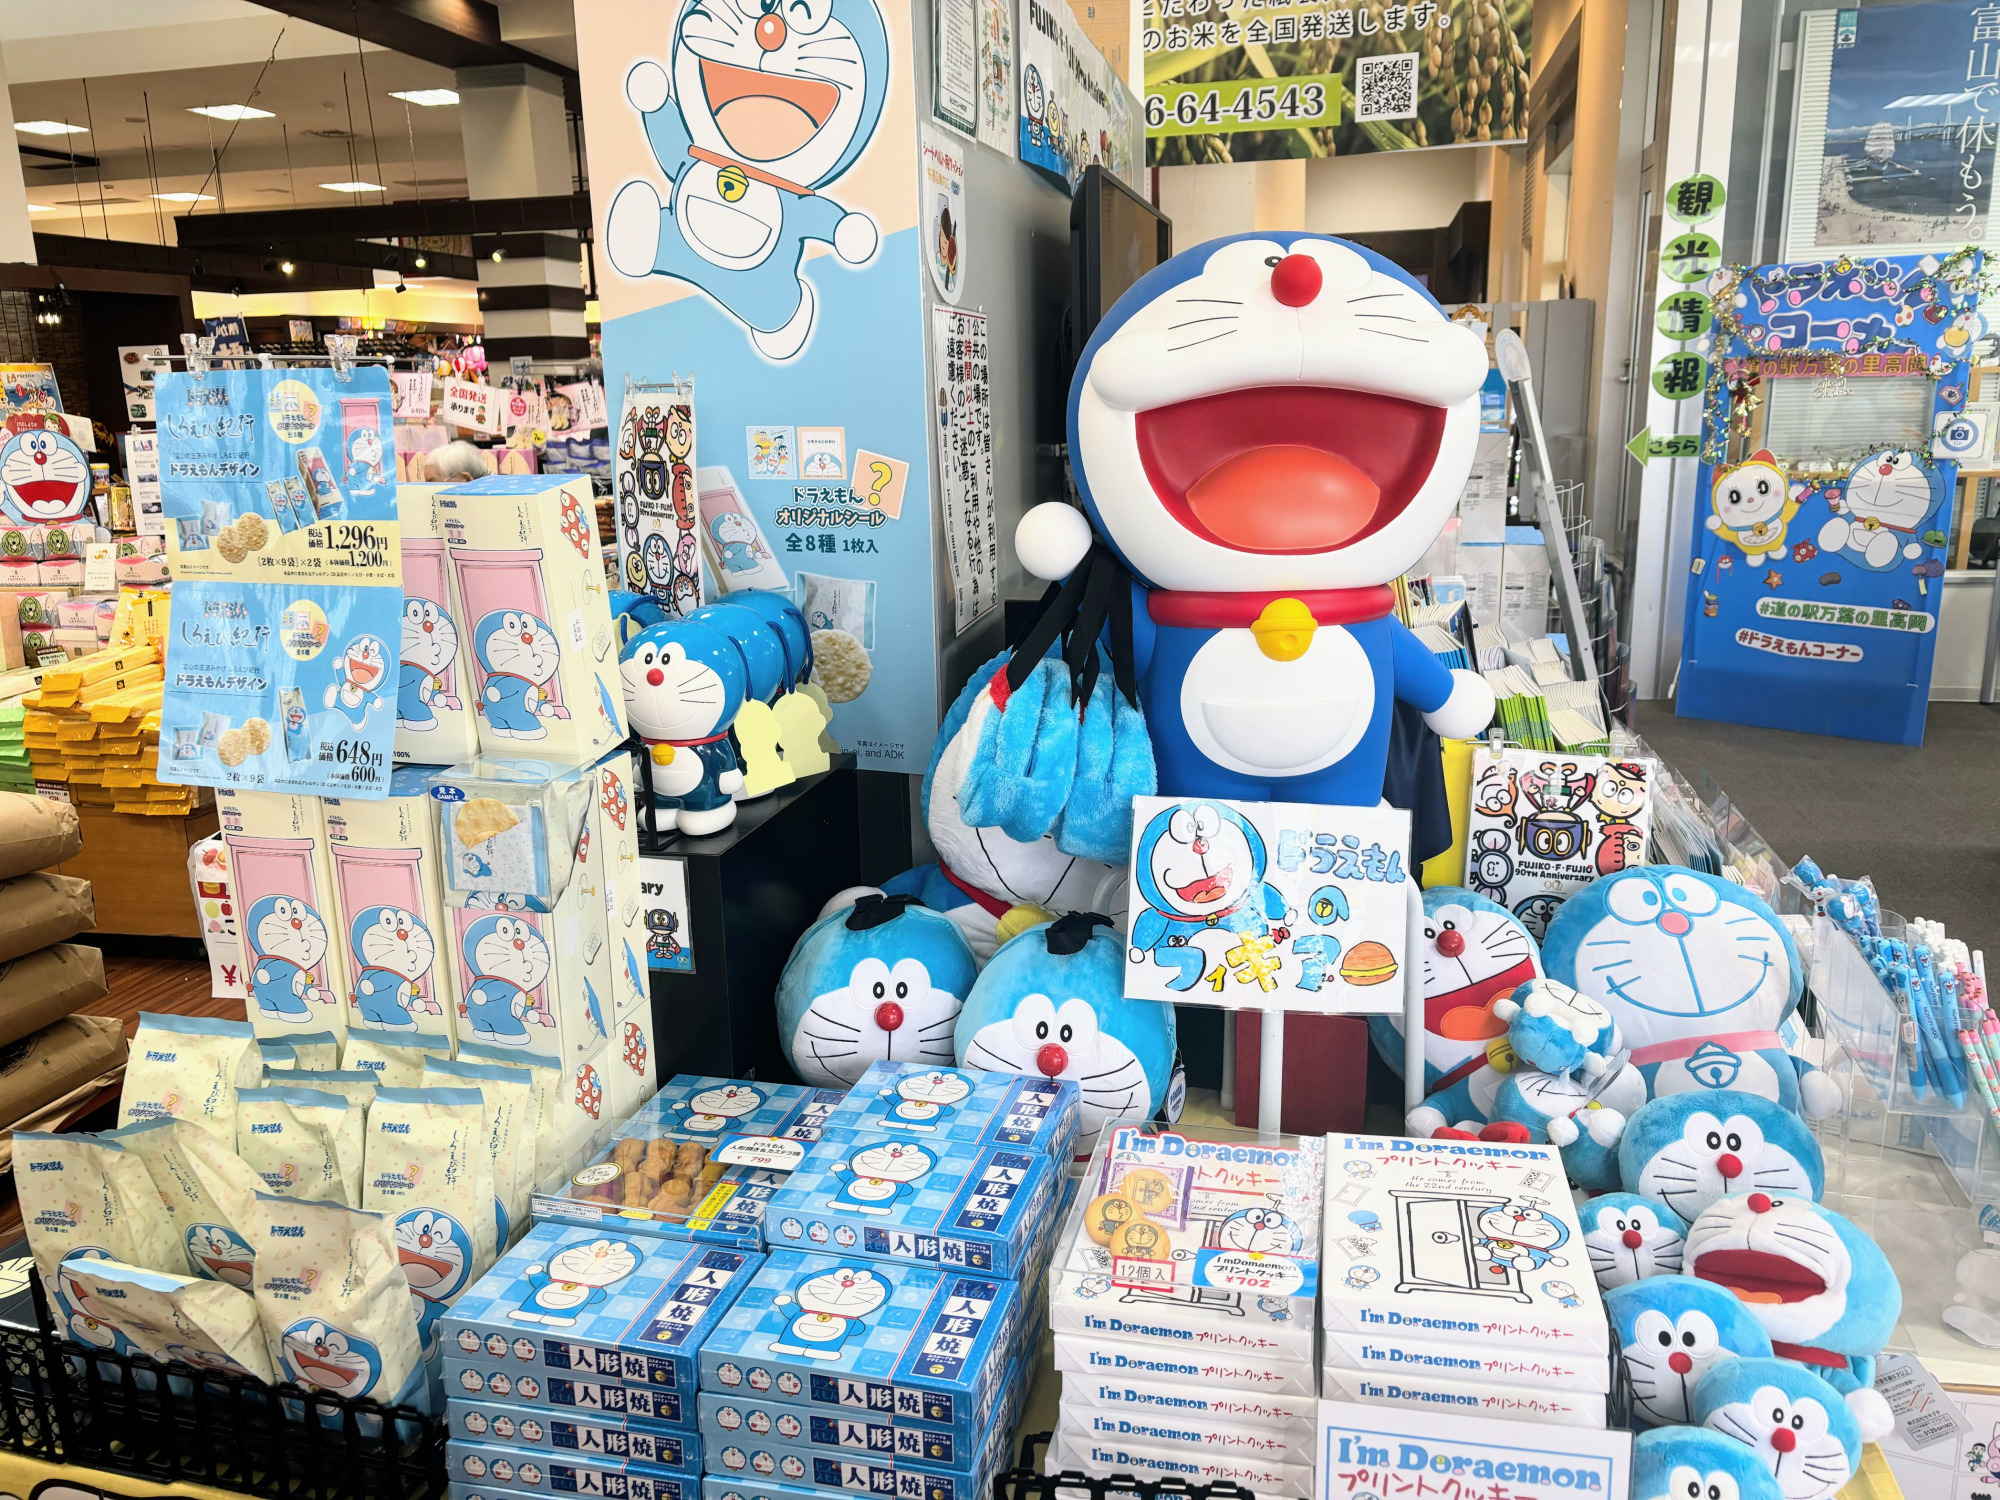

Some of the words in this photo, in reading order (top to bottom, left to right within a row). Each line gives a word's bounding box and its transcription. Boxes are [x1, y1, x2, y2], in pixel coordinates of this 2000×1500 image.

[1143, 3, 1451, 52] のお米を全国発送します。
[1145, 83, 1326, 127] 6-64-4543
[1663, 181, 1713, 393] 観光情報
[450, 386, 487, 404] 全国発送
[450, 402, 475, 415] 承ります
[1649, 437, 1698, 455] こちら
[169, 462, 261, 478] ドラえもんデザイン
[793, 487, 865, 505] ドラえもん
[777, 507, 885, 528] オリジナルシール
[308, 528, 323, 538] 税込
[308, 538, 324, 548] 価格
[324, 525, 388, 551] 1,296円
[785, 533, 837, 553] 全8種
[843, 539, 879, 554] 1枚入
[1759, 601, 1928, 630] #道の駅万葉の里高岡
[1737, 630, 1860, 659] #ドラえもんコーナー
[176, 674, 268, 691] ドラえもんデザイン
[319, 742, 334, 751] 税込
[319, 752, 334, 762] 価格
[336, 739, 383, 767] 648円
[857, 740, 905, 749] 写真はイメージです
[866, 749, 882, 758] and
[884, 750, 905, 760] ADK
[437, 793, 460, 801] SAMPLE
[438, 786, 456, 795] 見本
[1277, 829, 1406, 883] ドラえもん
[1518, 861, 1551, 871] FUJIKO
[1565, 864, 1592, 874] FUJIO
[1515, 868, 1537, 878] 90TH
[1539, 870, 1594, 882] Anniversary
[1309, 885, 1349, 925] の
[1012, 1093, 1046, 1131] 人形焼
[1343, 1137, 1385, 1151] I'm
[1390, 1139, 1550, 1162] Doraemon
[1375, 1154, 1524, 1171] プリントクッキー
[733, 1174, 776, 1214] 人形焼
[975, 1168, 1013, 1212] 人形焼
[1424, 1182, 1452, 1190] 22nd
[1455, 1184, 1492, 1194] century
[1461, 1177, 1485, 1186] from
[40, 1210, 67, 1218] ドラえもん
[1217, 1199, 1239, 1207] from
[892, 1233, 964, 1263] 人形焼
[271, 1277, 303, 1286] ドラえもん
[1120, 1264, 1166, 1281] 12個入
[1213, 1265, 1299, 1278] プリントクッキー
[667, 1271, 716, 1321] 人形焼
[936, 1299, 977, 1355] 人形焼
[1085, 1315, 1107, 1329] I'm
[1110, 1318, 1193, 1340] Doraemon
[1196, 1331, 1278, 1348] プリントクッキー
[1361, 1308, 1384, 1324] I'm
[1387, 1312, 1480, 1333] Doraemon
[1482, 1323, 1574, 1339] プリントクッキー
[573, 1349, 646, 1379] 人形焼
[1090, 1351, 1112, 1366] I'm
[1115, 1355, 1199, 1375] Doraemon
[1201, 1366, 1284, 1382] プリントクッキー
[1362, 1345, 1386, 1361] I'm
[1389, 1348, 1481, 1370] Doraemon
[1484, 1361, 1575, 1377] プリントクッキー
[577, 1385, 651, 1413] 人形焼
[842, 1383, 920, 1414] 人形焼
[1099, 1386, 1121, 1401] I'm
[1124, 1389, 1208, 1410] Doraemon
[1210, 1401, 1293, 1418] プリントクッキー
[1360, 1382, 1384, 1397] I'm
[1387, 1385, 1479, 1406] Doraemon
[1482, 1396, 1572, 1413] プリントクッキー
[581, 1429, 654, 1458] 人形焼
[842, 1424, 920, 1454] 人形焼
[1093, 1417, 1116, 1432] I'm
[1118, 1421, 1202, 1442] Doraemon
[1204, 1432, 1287, 1450] プリントクッキー
[1091, 1448, 1114, 1463] I'm
[1116, 1452, 1200, 1474] Doraemon
[1202, 1465, 1284, 1483] プリントクッキー
[1338, 1436, 1390, 1467] I'm
[1398, 1443, 1601, 1490] Doraemon
[579, 1473, 653, 1500] 人形焼
[848, 1466, 923, 1498] 人形焼
